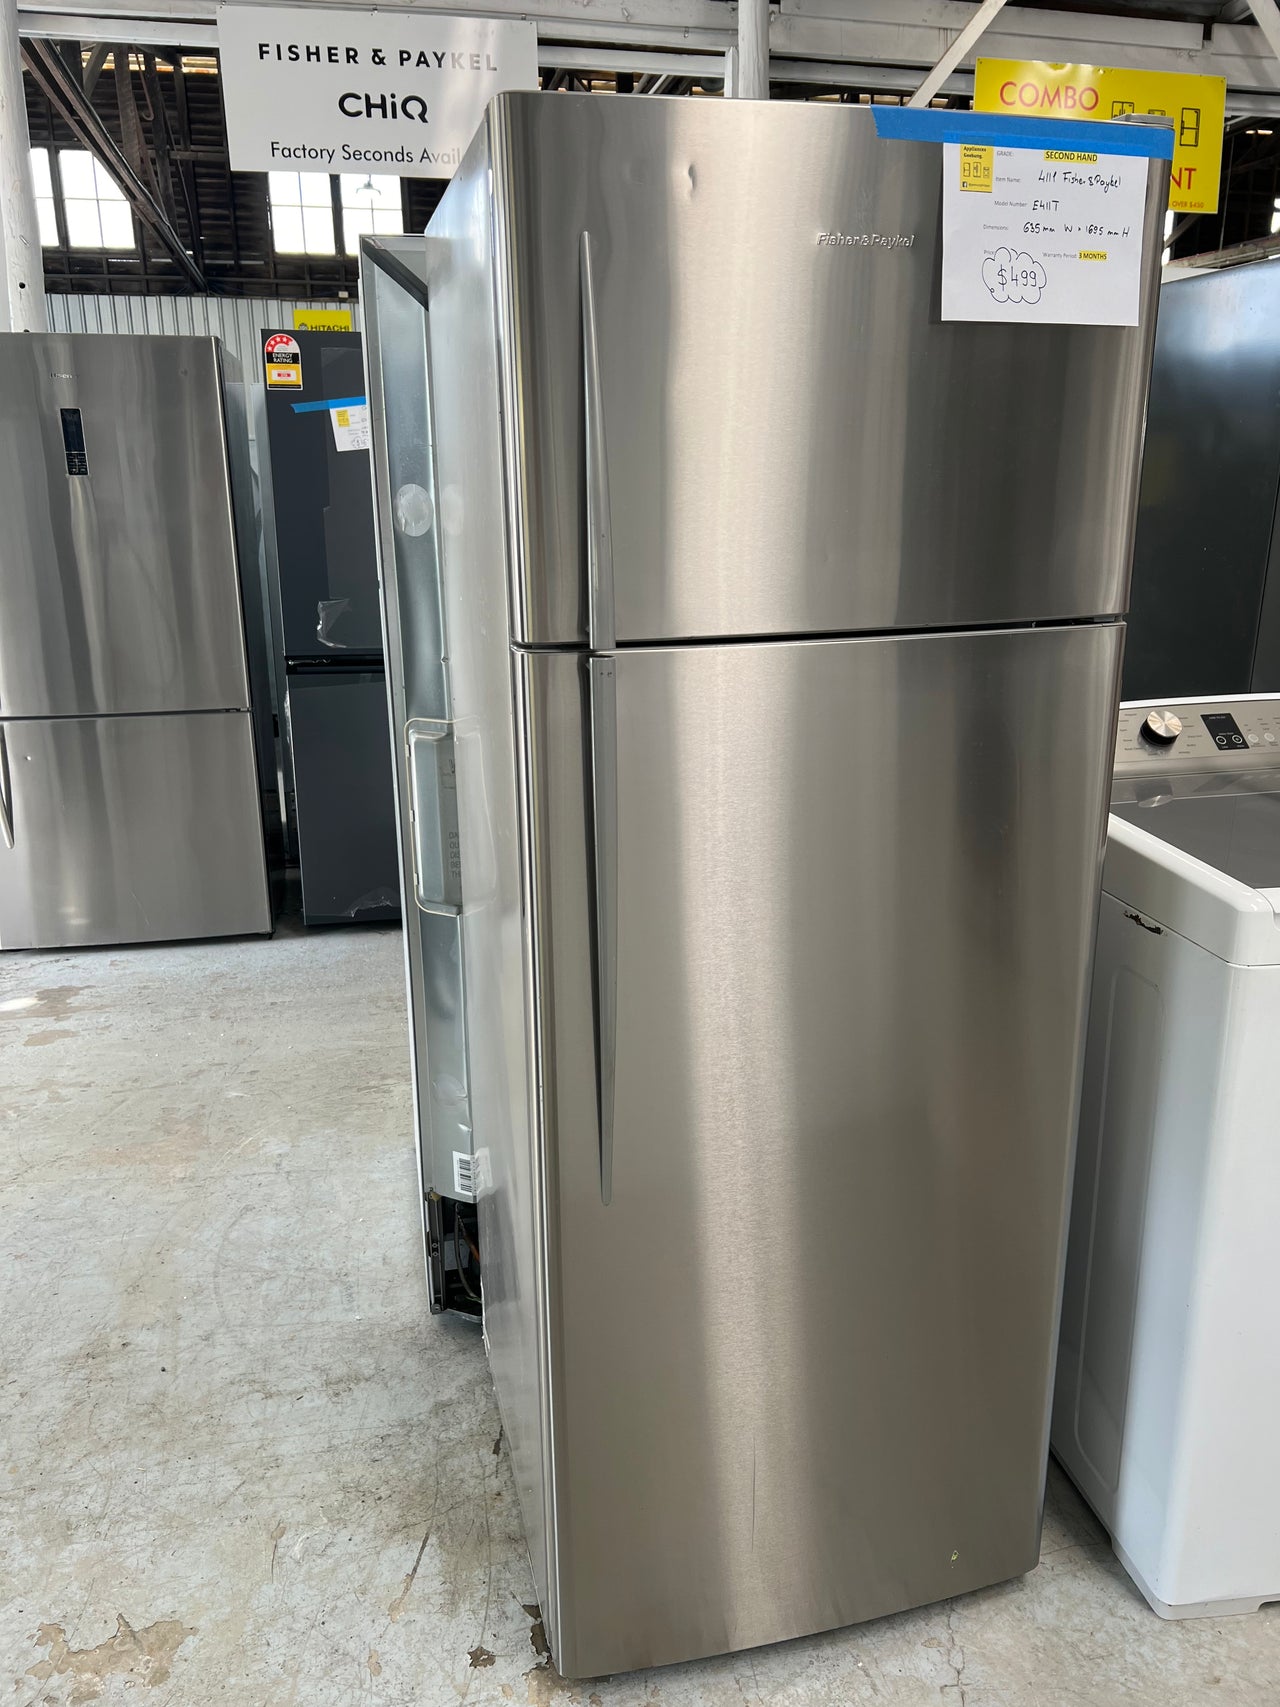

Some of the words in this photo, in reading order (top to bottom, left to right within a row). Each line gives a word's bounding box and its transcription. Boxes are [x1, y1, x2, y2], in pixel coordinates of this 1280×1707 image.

[258, 43, 359, 65] FISHER
[372, 49, 386, 65] &
[399, 50, 497, 71] PAYKEL
[338, 92, 428, 123] CHiQ
[1000, 81, 1099, 111] COMBO
[270, 141, 334, 164] Factory
[341, 144, 413, 163] Seconds
[1045, 151, 1075, 160] SECOND
[1076, 153, 1098, 162] HAND
[997, 264, 1037, 291] $499
[310, 324, 350, 332] HITACHI
